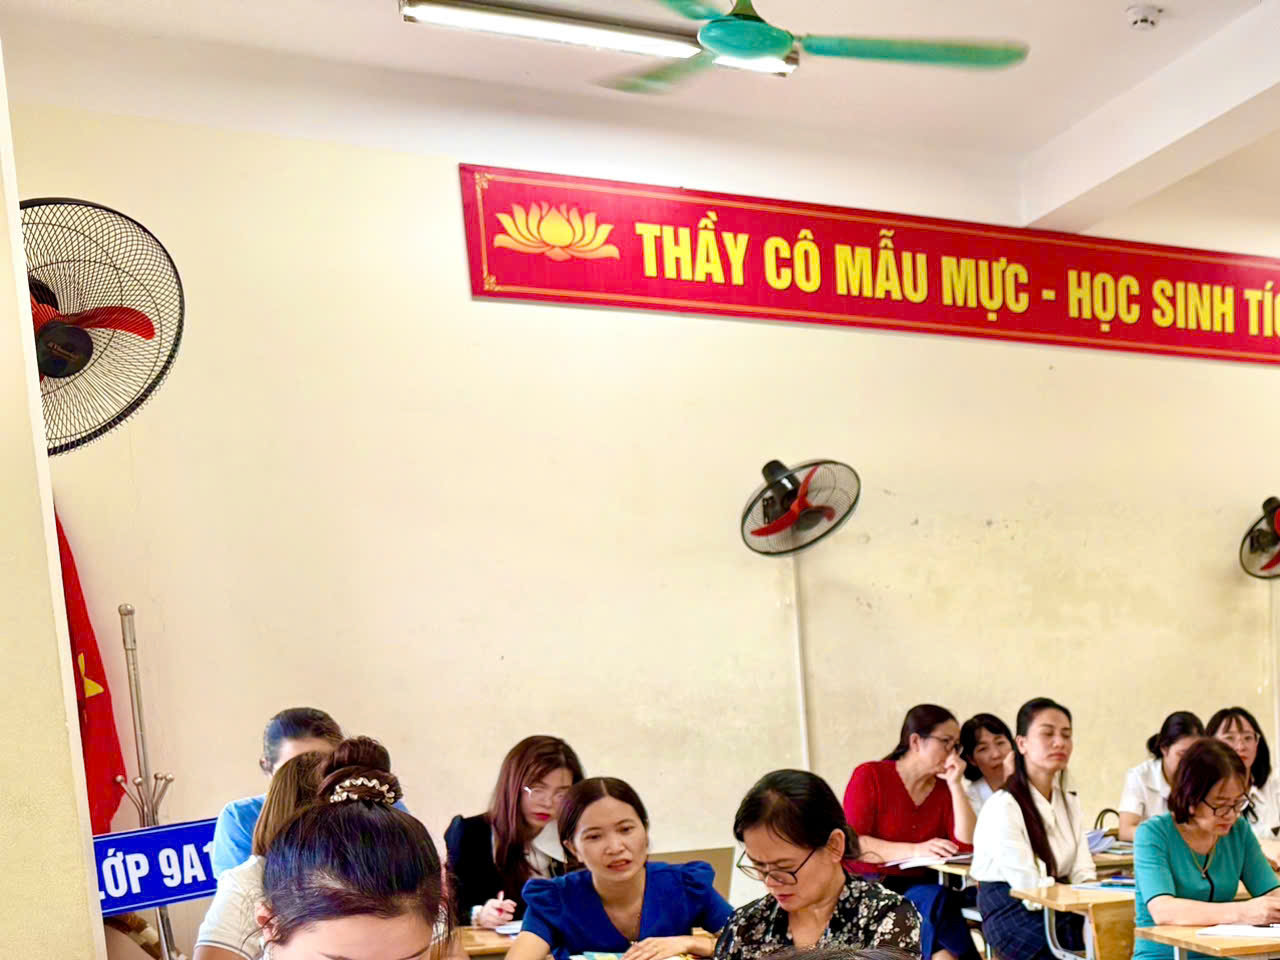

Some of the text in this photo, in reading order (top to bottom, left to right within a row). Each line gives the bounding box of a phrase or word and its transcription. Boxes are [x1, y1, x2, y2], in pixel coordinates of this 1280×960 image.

[635, 211, 749, 286] THẦY
[764, 230, 821, 293] CÔ
[835, 229, 928, 304] MẪU
[942, 256, 1030, 321] MỰC
[1041, 288, 1056, 300] -
[1067, 270, 1140, 332] HỌC
[1152, 279, 1234, 334] SINH
[99, 848, 150, 900] ỚP
